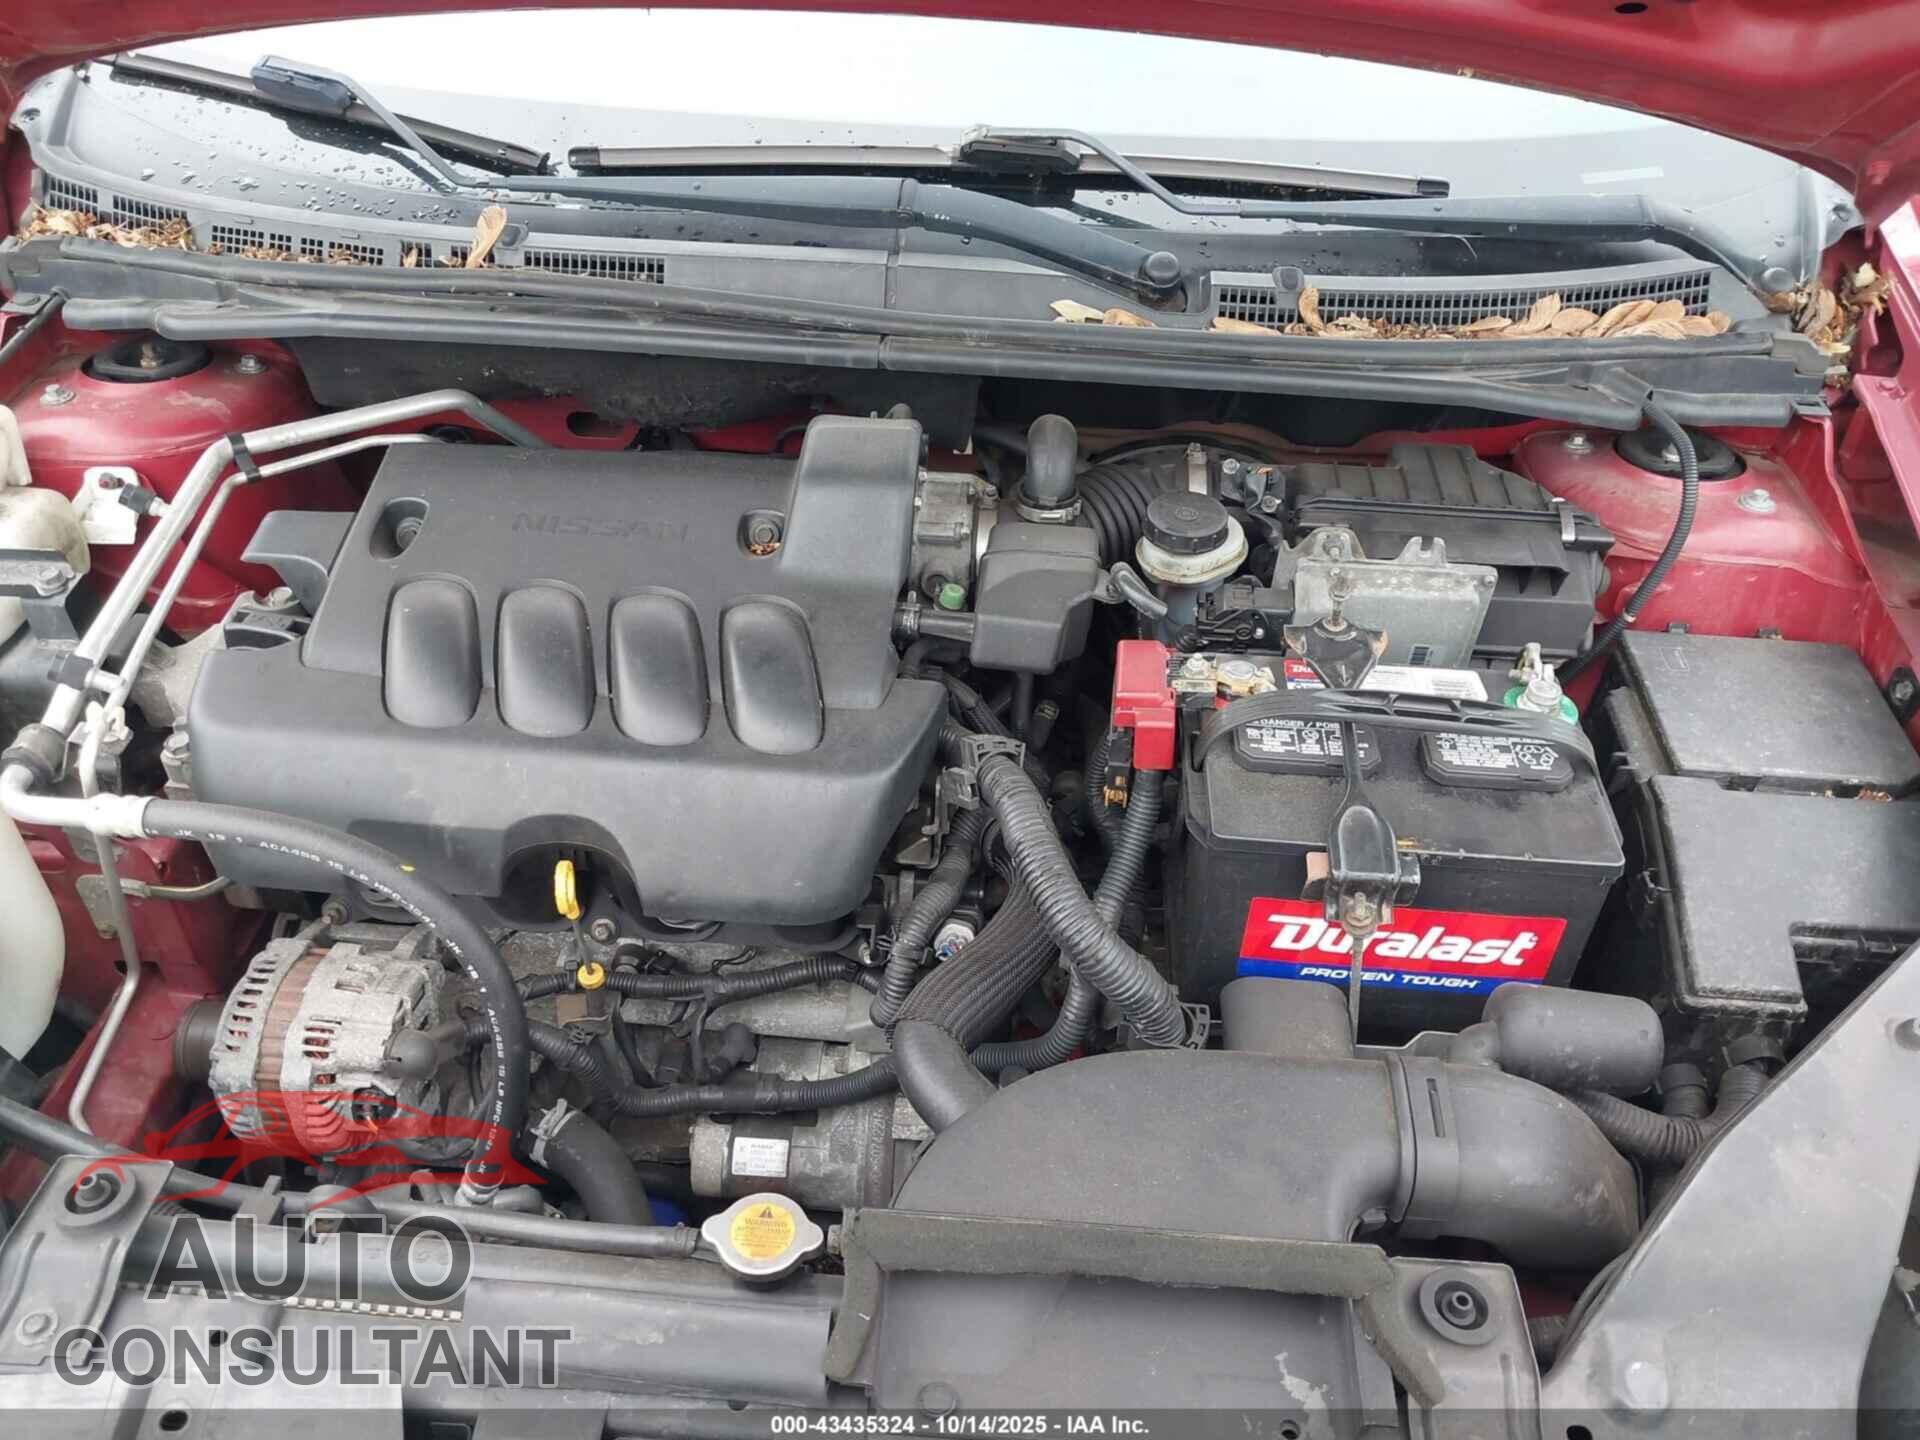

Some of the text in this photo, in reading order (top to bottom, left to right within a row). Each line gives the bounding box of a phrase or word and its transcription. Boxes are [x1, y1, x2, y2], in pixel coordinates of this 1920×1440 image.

[512, 512, 690, 543] NISSAN
[1300, 966, 1480, 989] PROEN TOUGH
